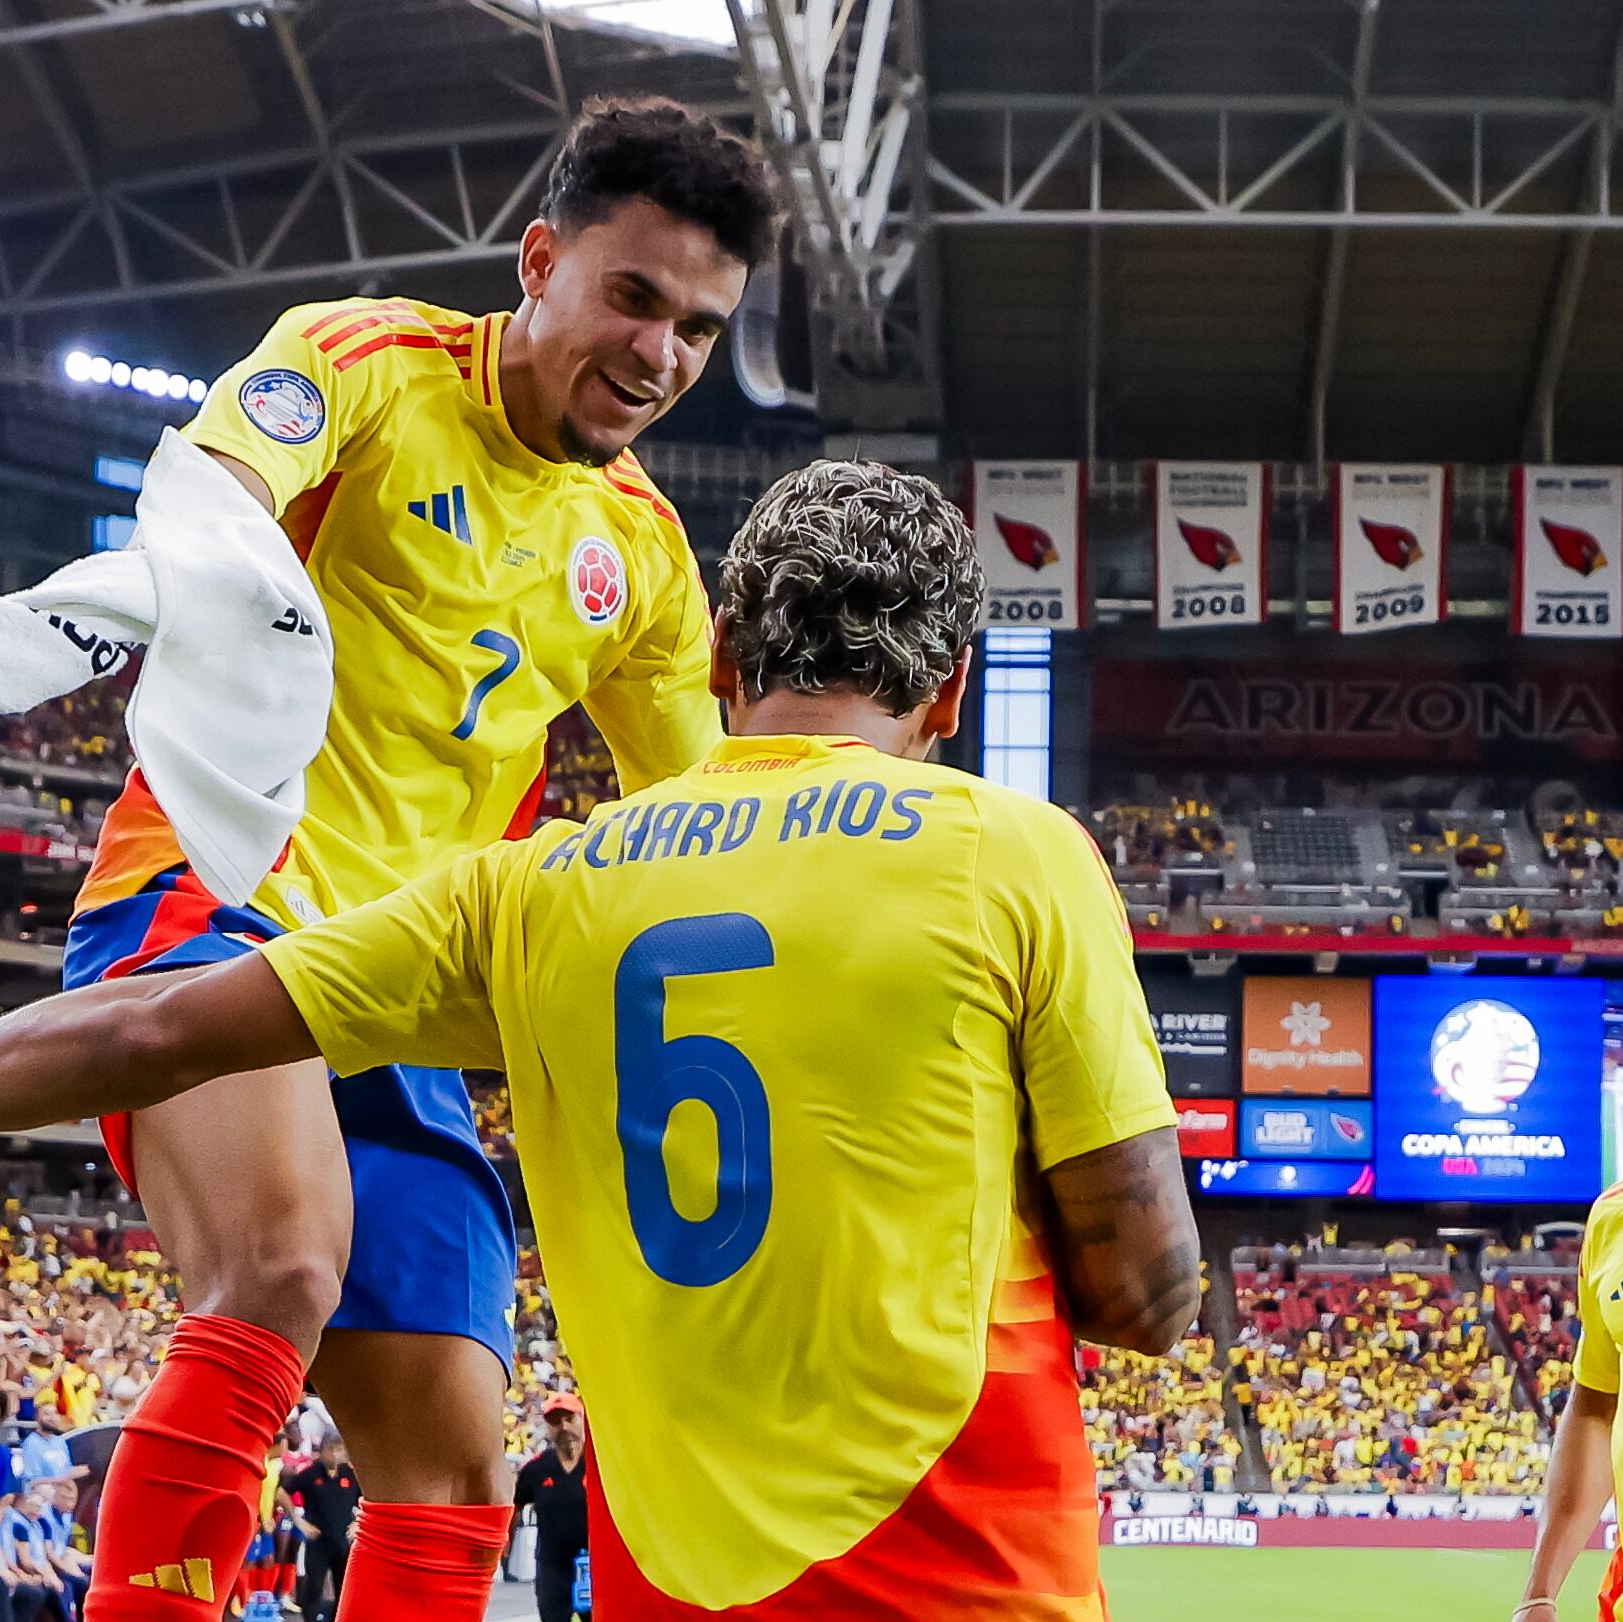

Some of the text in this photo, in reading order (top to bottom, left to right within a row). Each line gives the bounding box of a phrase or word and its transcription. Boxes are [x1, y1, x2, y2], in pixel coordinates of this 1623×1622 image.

[989, 601, 1063, 620] 2008
[1172, 595, 1246, 619] 2008
[1355, 595, 1425, 625] 2009
[451, 629, 521, 741] 7
[1164, 679, 1619, 742] ARIZONA
[702, 758, 800, 775] COLOMBIA
[778, 779, 934, 842] RIOS
[1161, 1013, 1228, 1031] RIVER
[614, 912, 775, 1288] 6
[1402, 1134, 1566, 1158] COPA AMERICA
[1113, 1517, 1258, 1546] CENTENARIO
